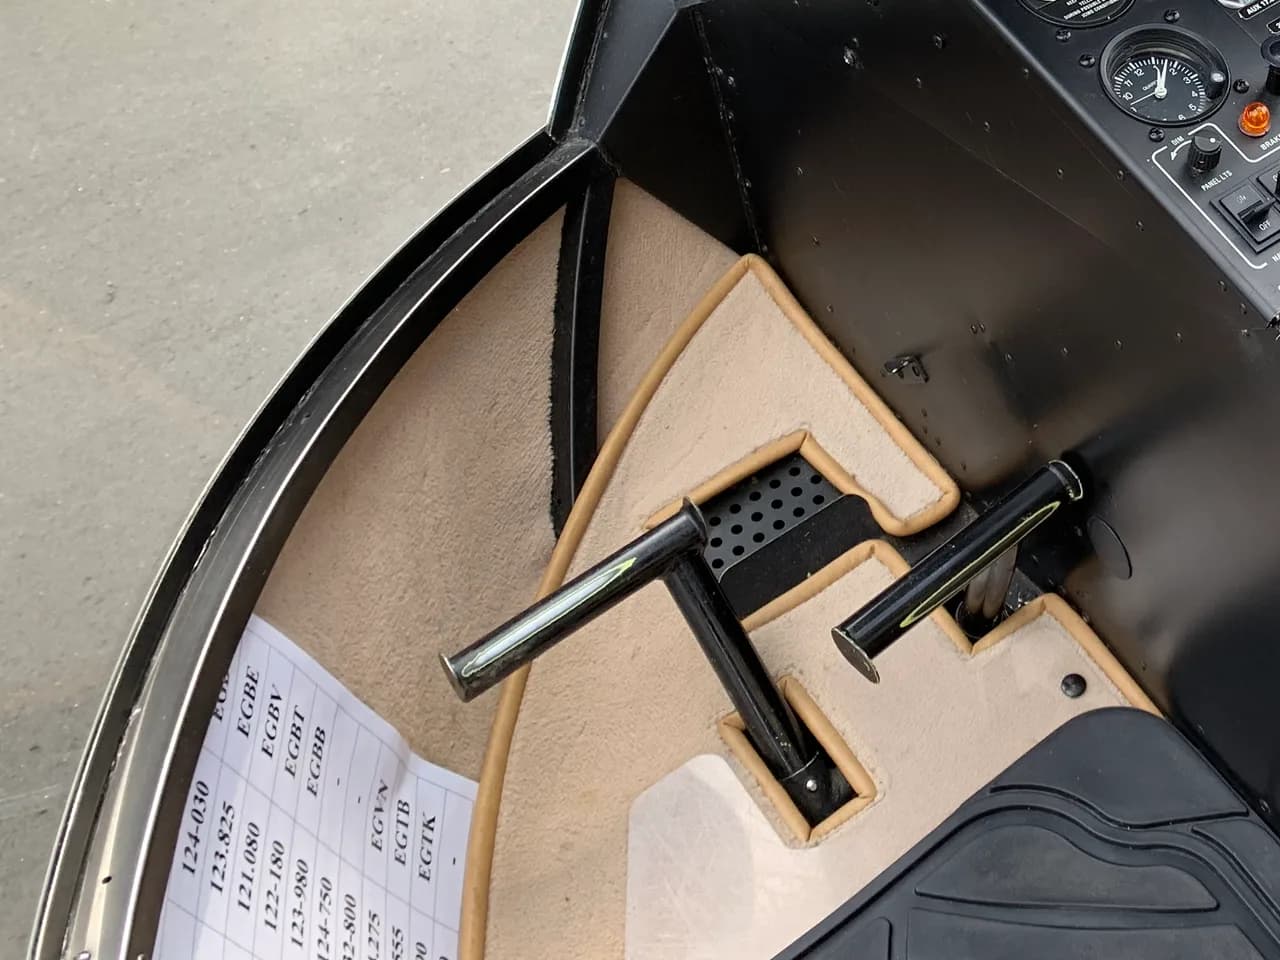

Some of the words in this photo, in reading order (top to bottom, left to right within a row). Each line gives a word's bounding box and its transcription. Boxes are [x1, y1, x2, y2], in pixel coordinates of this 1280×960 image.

[1246, 4, 1261, 16] AUX
[1170, 135, 1185, 146] DIM
[1201, 175, 1221, 192] PANEL
[1219, 169, 1233, 181] LTS
[1259, 219, 1272, 231] OFF
[236, 666, 260, 738] EGBE
[262, 684, 284, 759] EGBV
[285, 705, 306, 778] EGBT
[306, 726, 326, 797] EGBB
[182, 780, 210, 875] 124-030
[210, 801, 236, 894] 123.825
[371, 780, 389, 852] EGVN
[394, 800, 411, 866] EGTB
[418, 814, 437, 882] EGTK
[238, 822, 261, 912] 121.080
[264, 840, 286, 932] 122-180
[291, 859, 309, 948] 123-980
